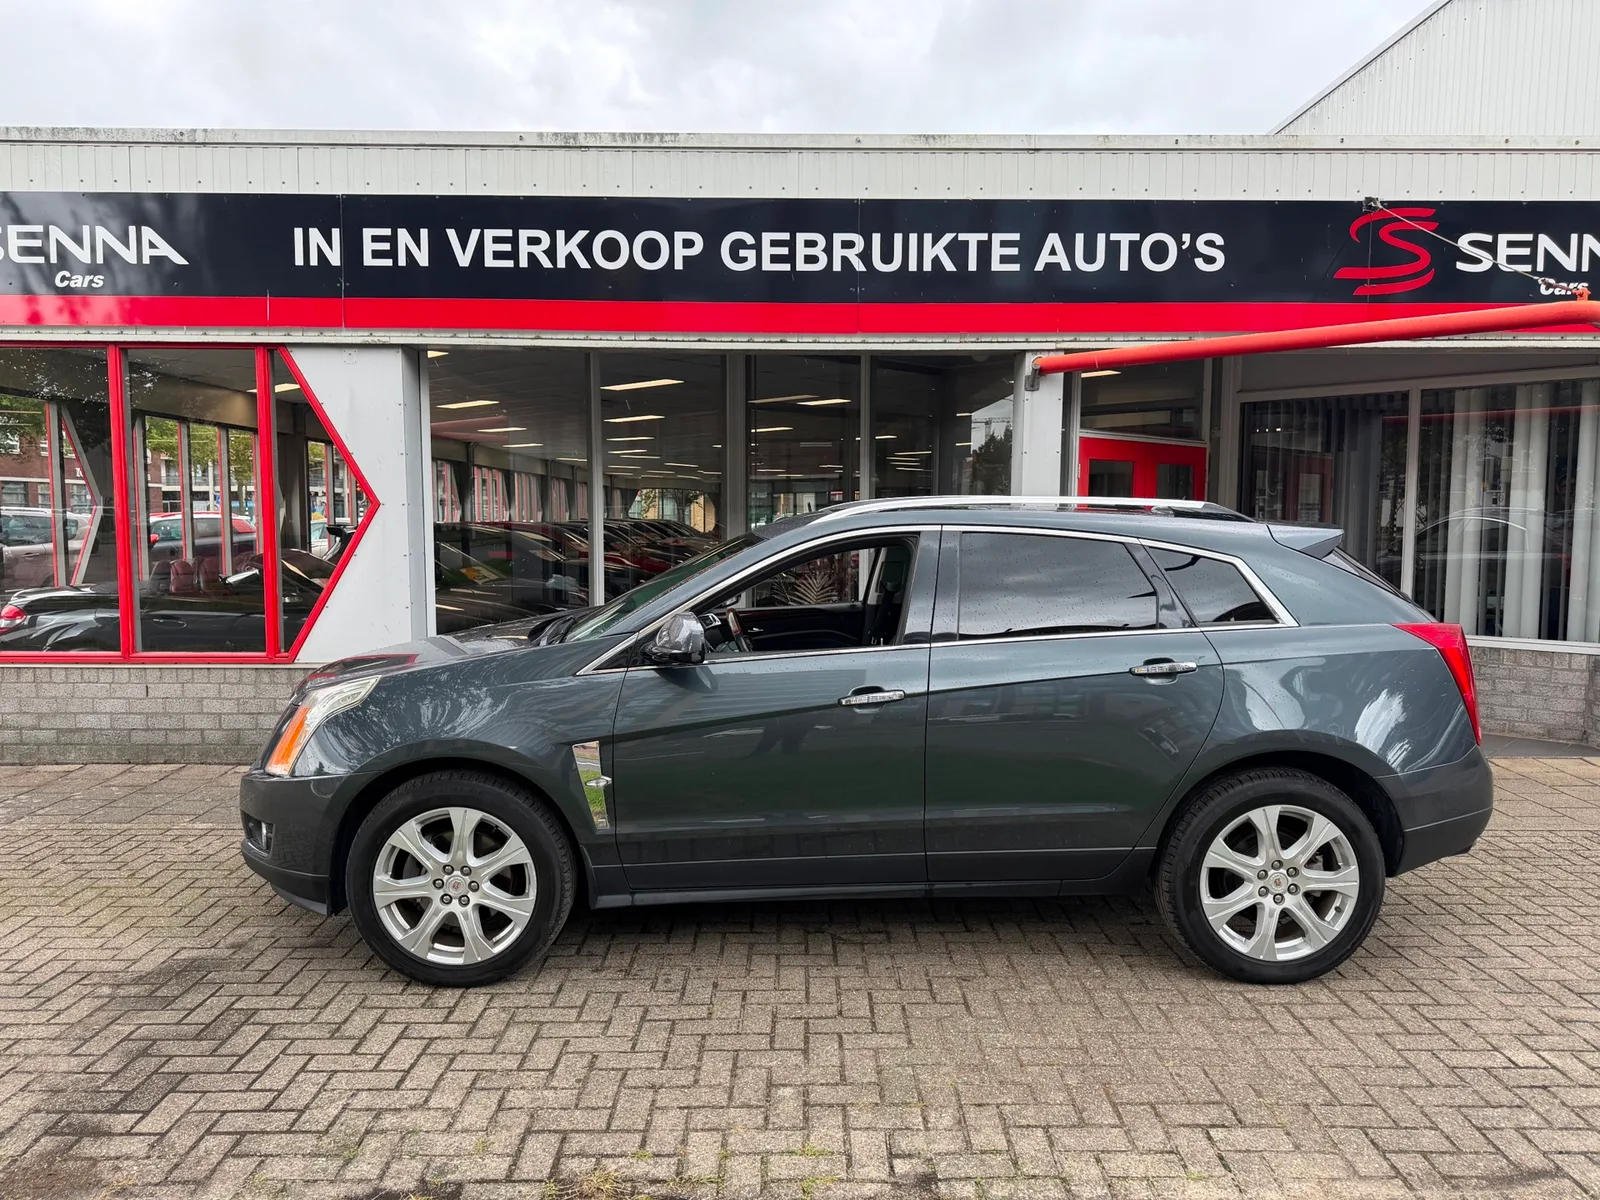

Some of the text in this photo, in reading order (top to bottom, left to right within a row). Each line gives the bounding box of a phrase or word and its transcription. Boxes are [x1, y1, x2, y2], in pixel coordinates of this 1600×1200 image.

[0, 226, 189, 265] ENNA
[294, 228, 1225, 273] IN EN VERKOOP GEBRUIKTE AUTO'S
[55, 271, 104, 287] Cars
